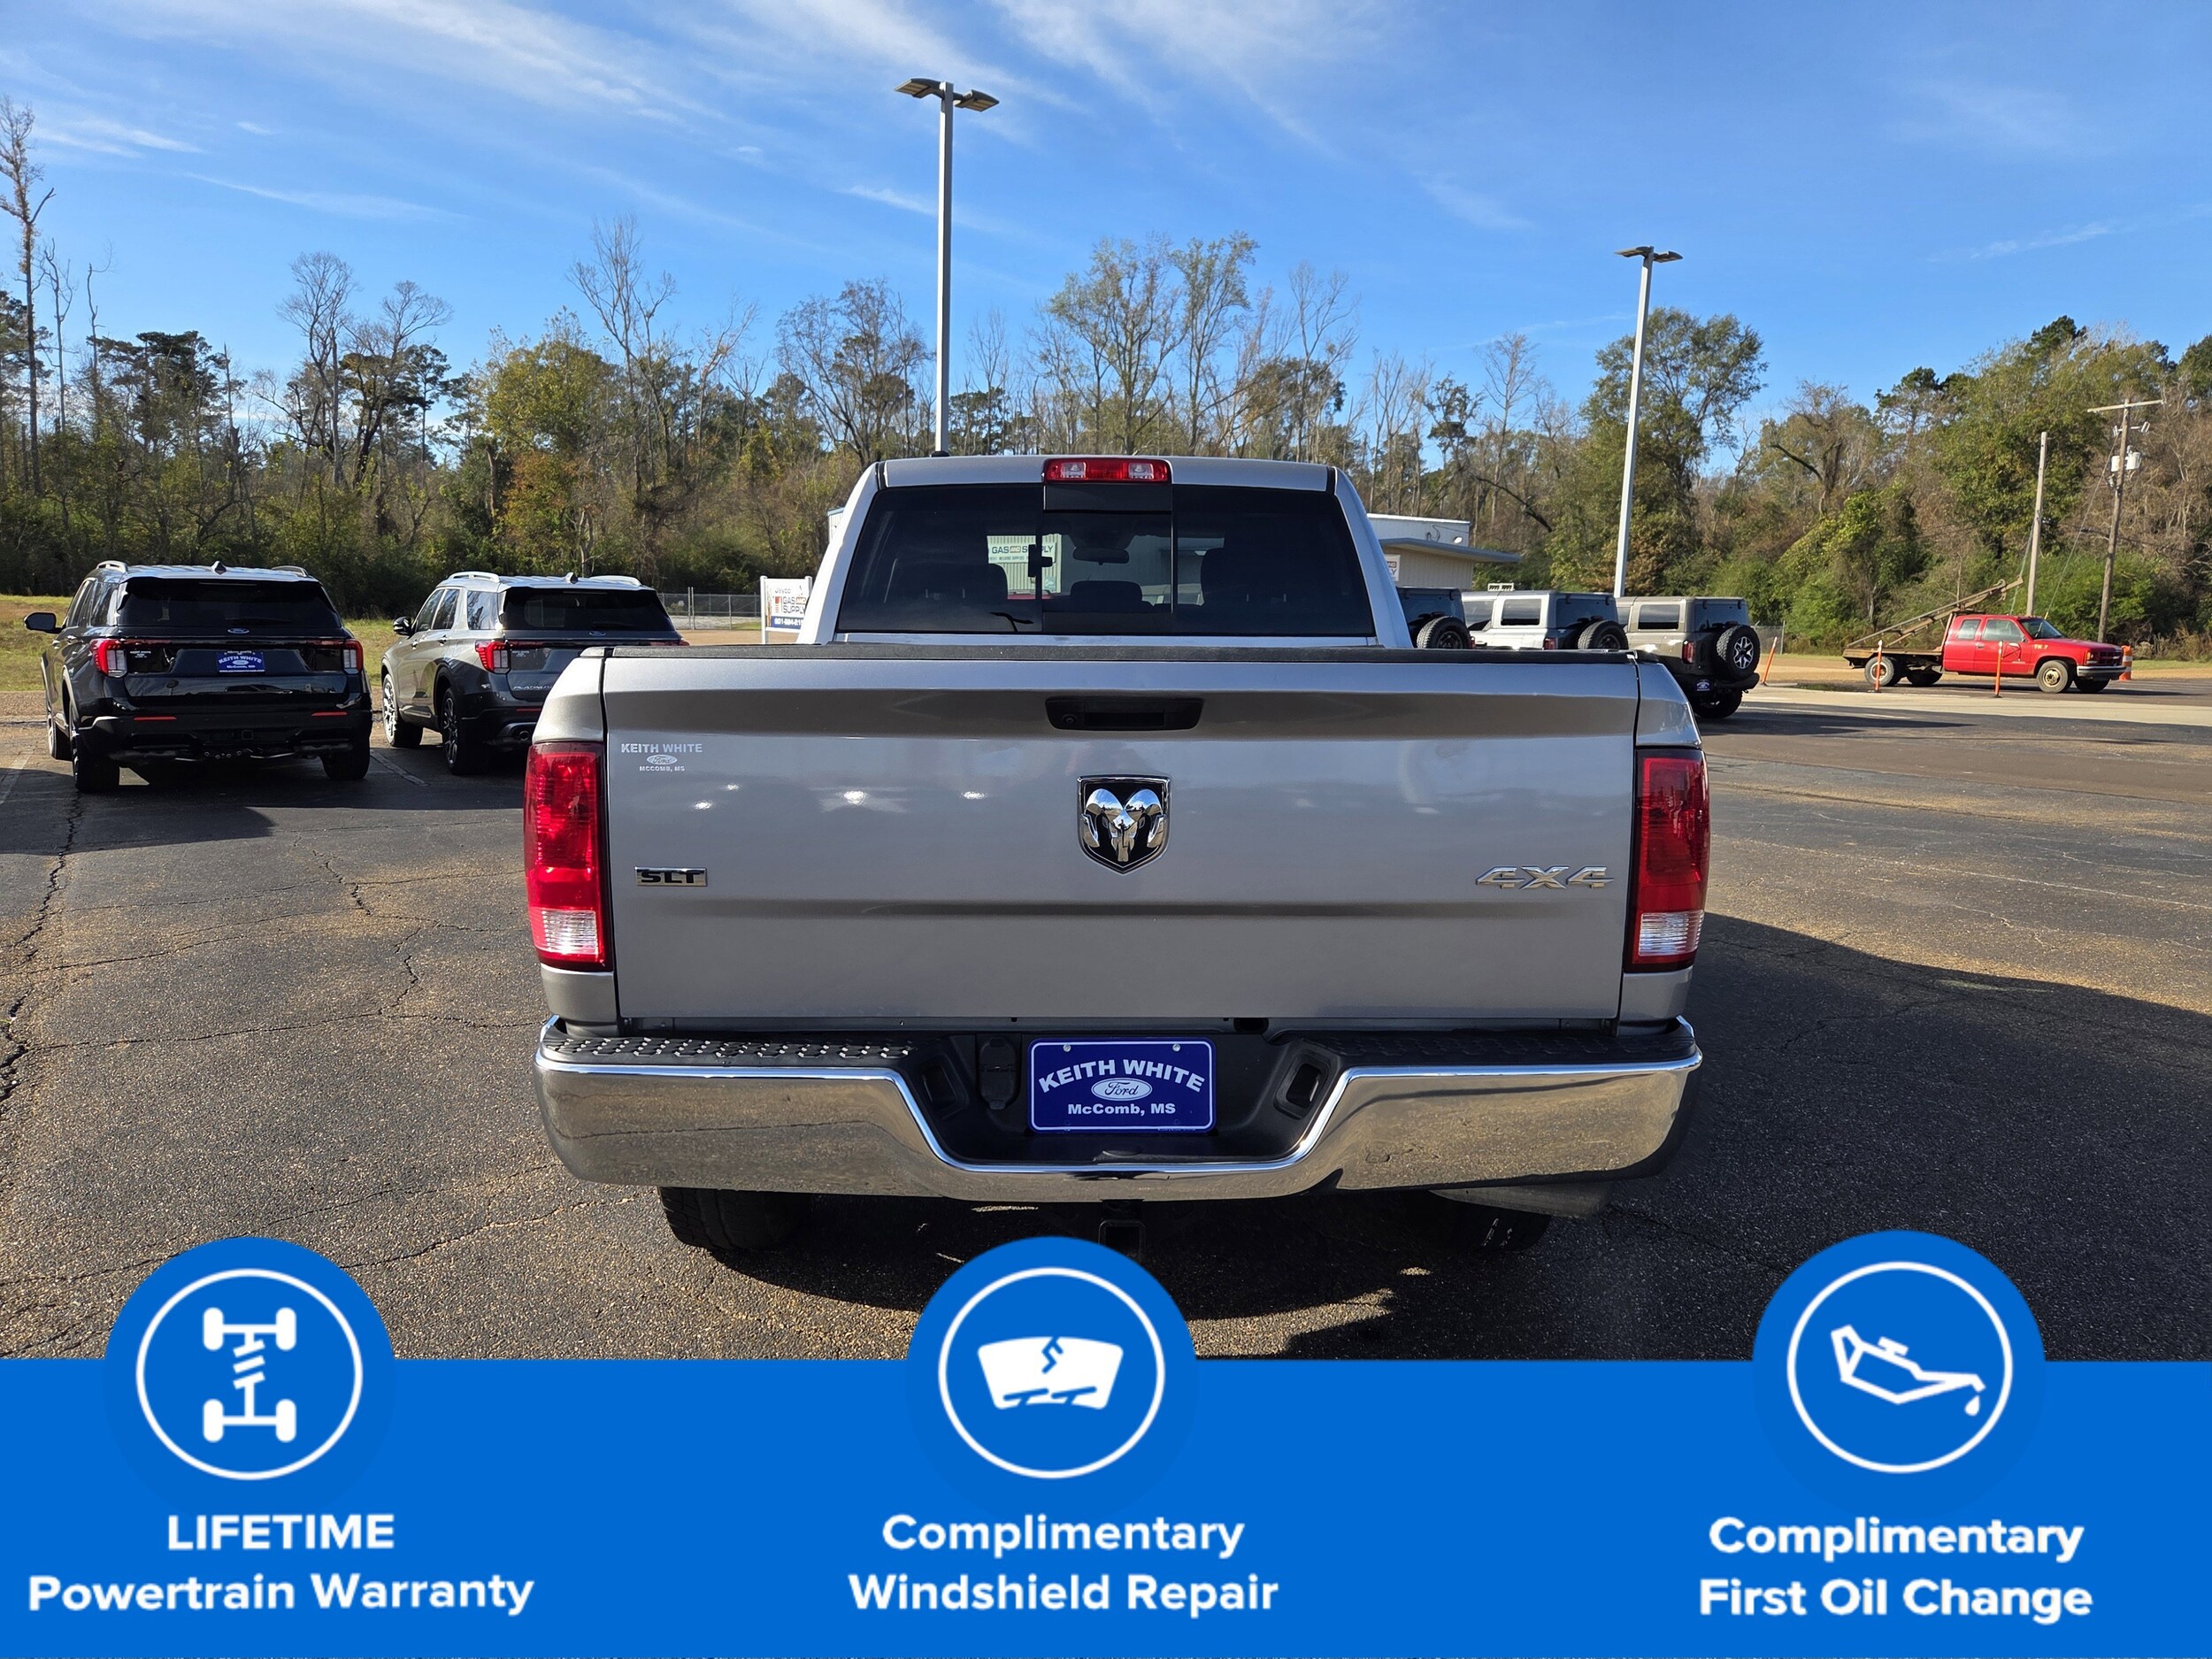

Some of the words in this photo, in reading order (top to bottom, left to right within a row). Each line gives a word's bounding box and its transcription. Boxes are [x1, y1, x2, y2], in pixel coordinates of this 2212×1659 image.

[782, 596, 795, 605] GAS
[621, 743, 659, 753] KEITH
[662, 743, 703, 753] WHITE
[641, 869, 704, 883] SLT
[1476, 866, 1615, 889] 4X4
[1038, 1059, 1117, 1094] KEITH
[1123, 1059, 1206, 1093] WHITE
[1104, 1081, 1139, 1096] Ford
[1067, 1103, 1146, 1117] McComb,
[1150, 1102, 1176, 1114] MS
